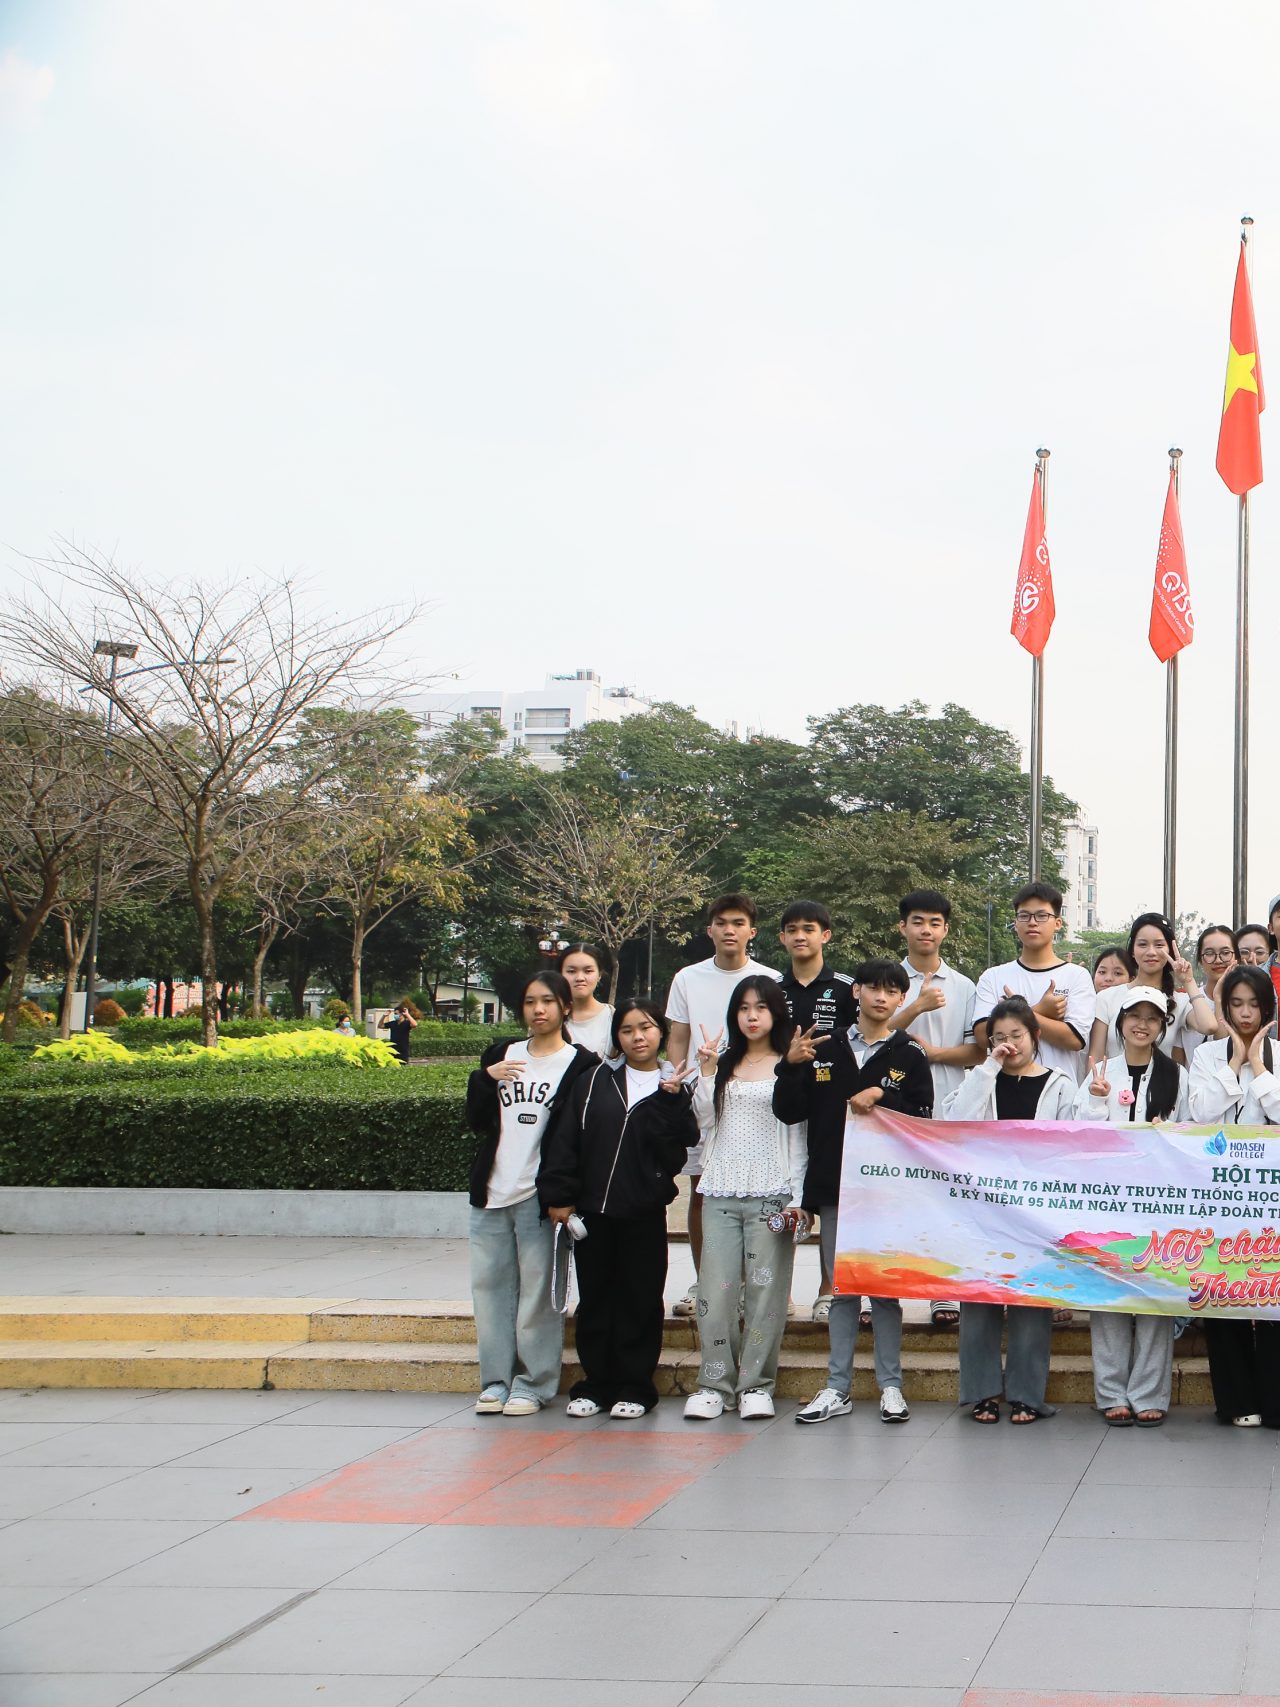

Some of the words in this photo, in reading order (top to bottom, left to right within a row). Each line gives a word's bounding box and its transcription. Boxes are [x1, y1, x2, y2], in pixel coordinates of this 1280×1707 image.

[815, 1004, 837, 1013] INEOS
[1229, 1151, 1265, 1159] COLLEGE
[860, 1164, 901, 1177] CHÀO
[905, 1166, 950, 1182] MỪNG
[977, 1176, 1018, 1191] NIỆM
[1022, 1180, 1038, 1192] 76
[1042, 1180, 1077, 1194] NĂM
[1081, 1182, 1122, 1196] NGÀY
[1125, 1183, 1187, 1198] TRUYỀN
[1191, 1186, 1243, 1201] THỐNG
[1248, 1191, 1280, 1205] HỌC
[1212, 1164, 1251, 1187] HỘI
[949, 1187, 958, 1198] &
[984, 1191, 1023, 1206] NIỆM
[1028, 1197, 1044, 1208] 95
[1048, 1196, 1084, 1210] NĂM
[1087, 1199, 1128, 1213] NGÀY
[1132, 1201, 1184, 1215] THÀNH
[1189, 1203, 1218, 1218] LẬP
[1221, 1204, 1263, 1218] ĐOÀN
[1132, 1227, 1215, 1273] Một
